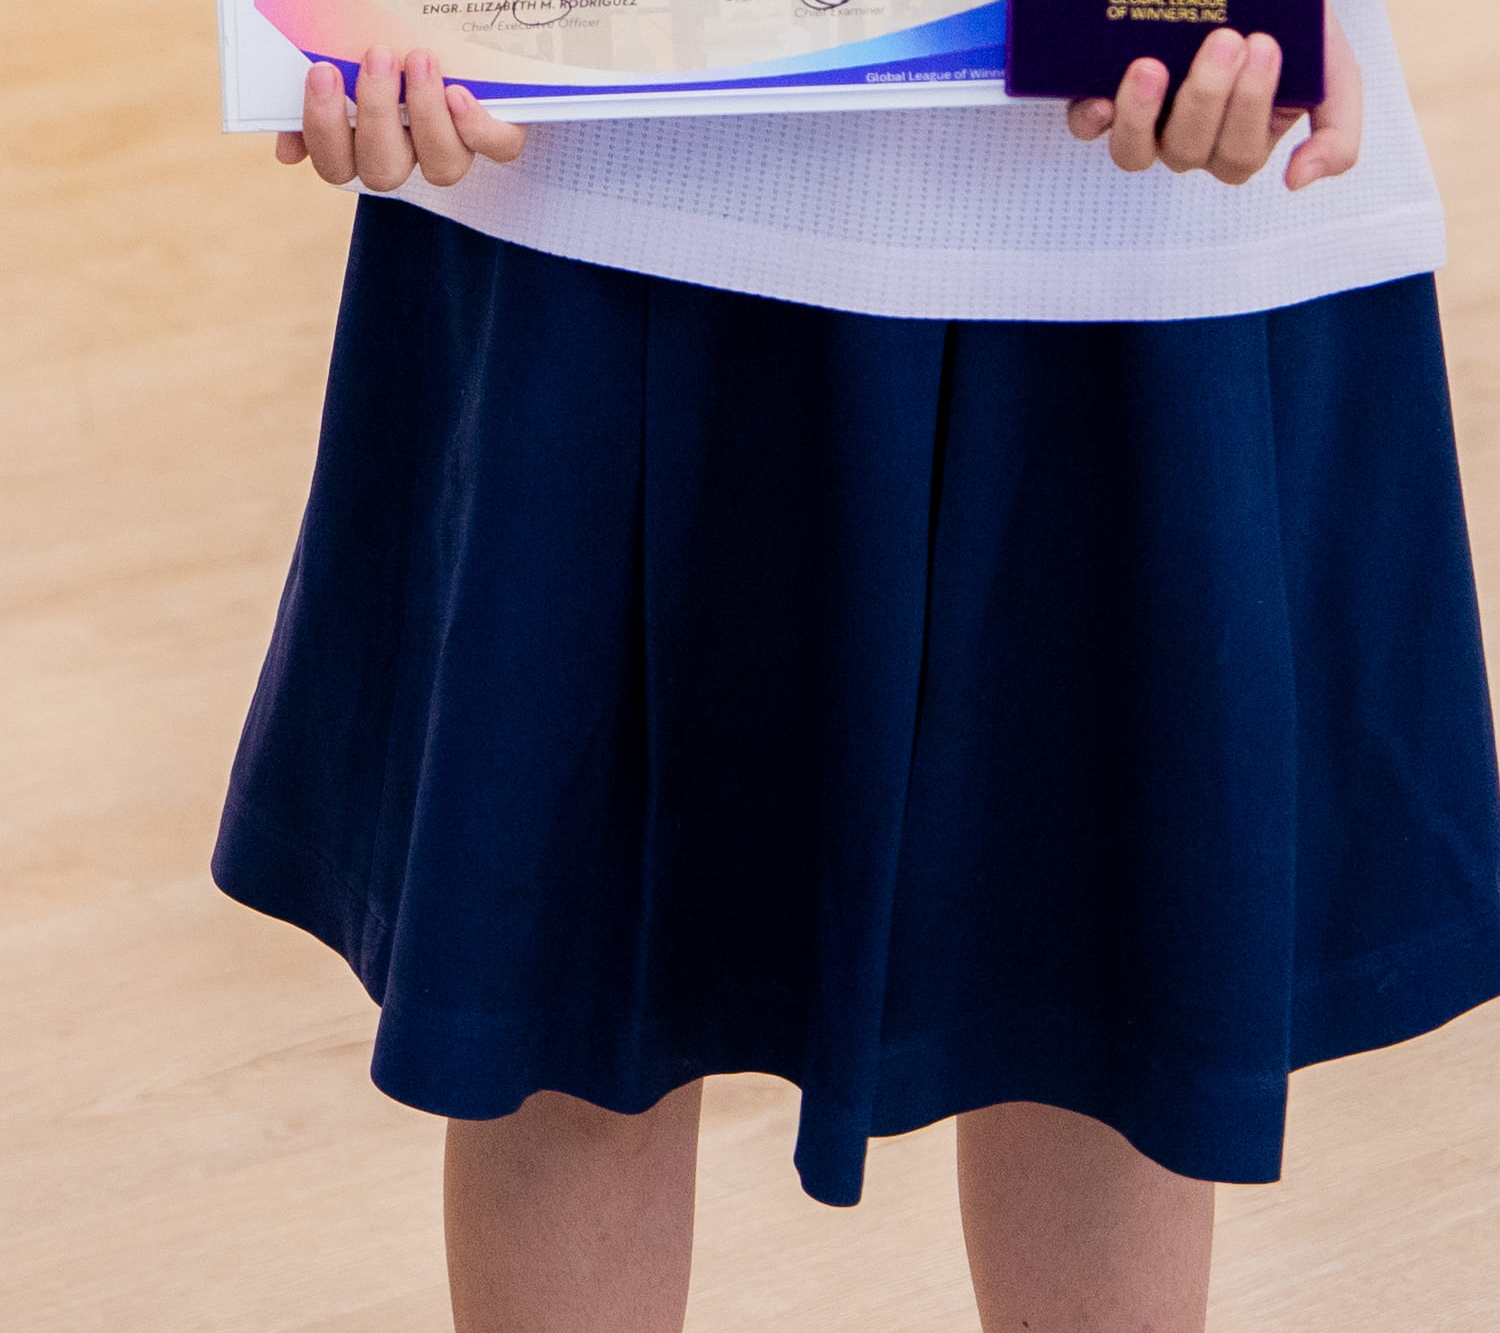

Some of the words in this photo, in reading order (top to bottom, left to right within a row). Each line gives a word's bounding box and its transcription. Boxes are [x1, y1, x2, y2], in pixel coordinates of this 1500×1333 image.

[422, 3, 463, 15] ENGR.
[540, 0, 556, 10] M.
[1106, 6, 1128, 20] OF
[558, 17, 601, 30] Officer
[866, 71, 906, 83] Global
[908, 70, 951, 84] League
[953, 68, 967, 80] of
